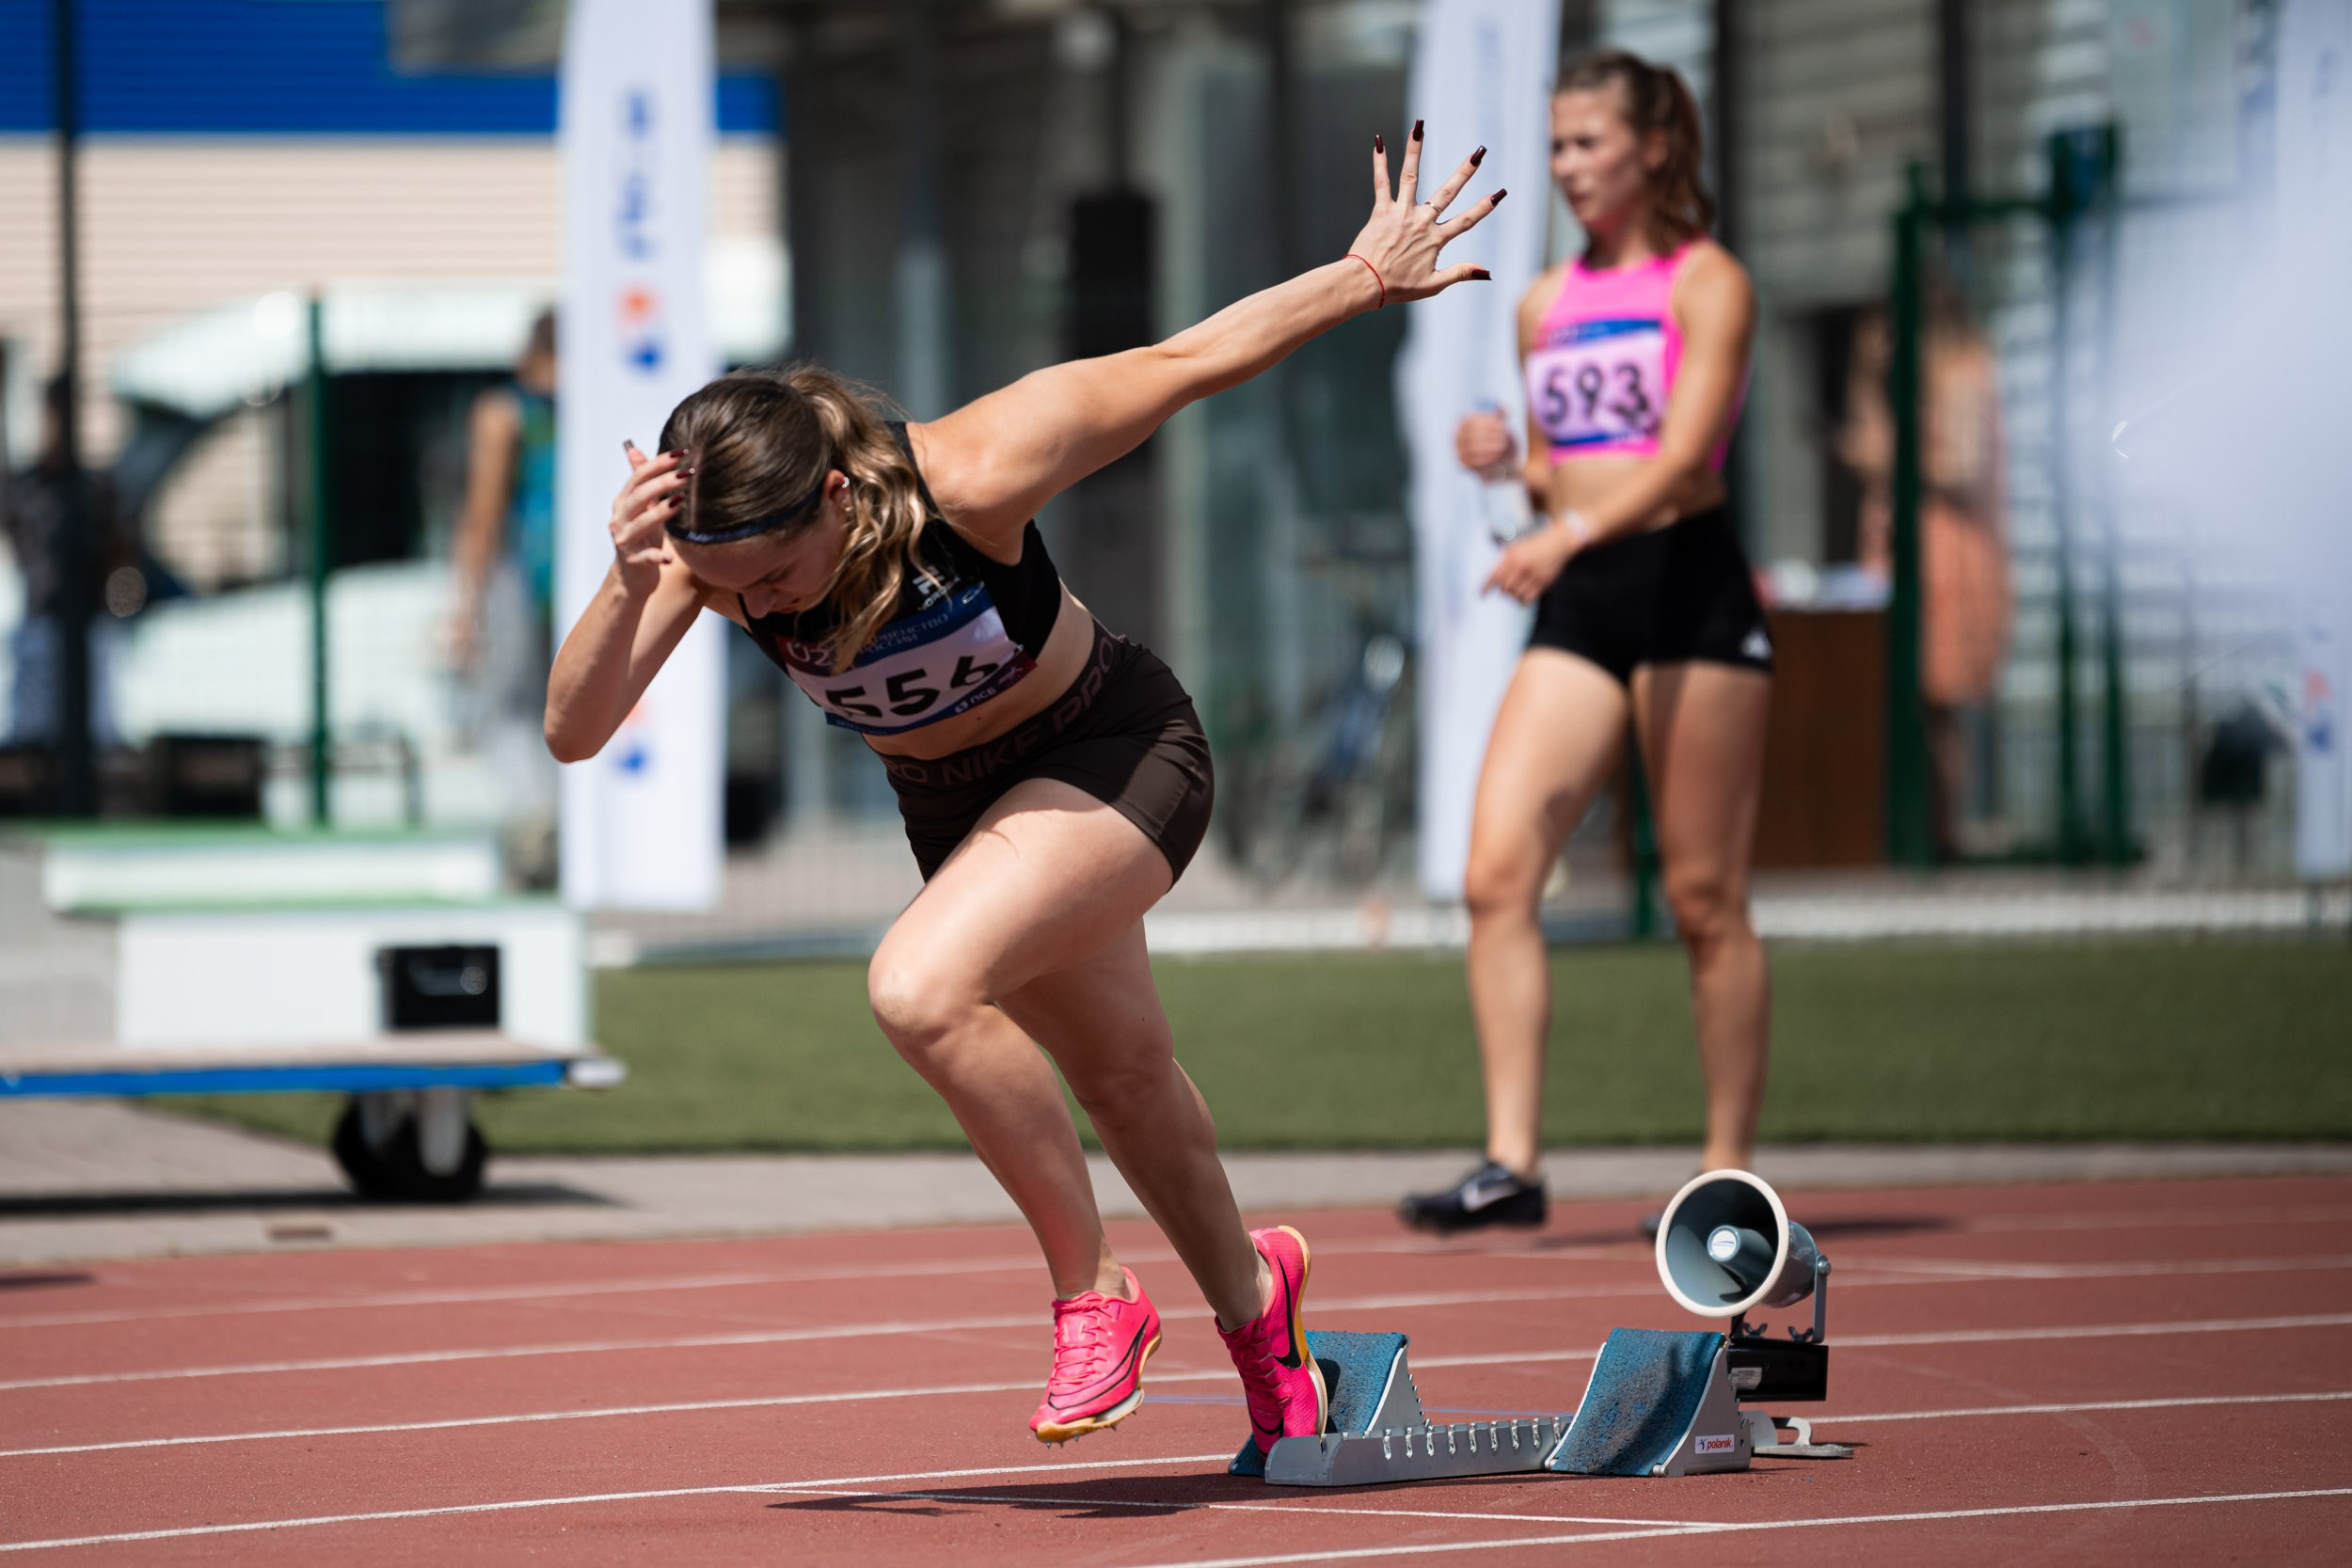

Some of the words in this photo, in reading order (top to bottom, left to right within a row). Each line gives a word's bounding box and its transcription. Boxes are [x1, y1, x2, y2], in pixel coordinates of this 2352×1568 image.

[1543, 361, 1650, 428] 593
[826, 656, 998, 717] 556
[1707, 1437, 1732, 1451] polanik
